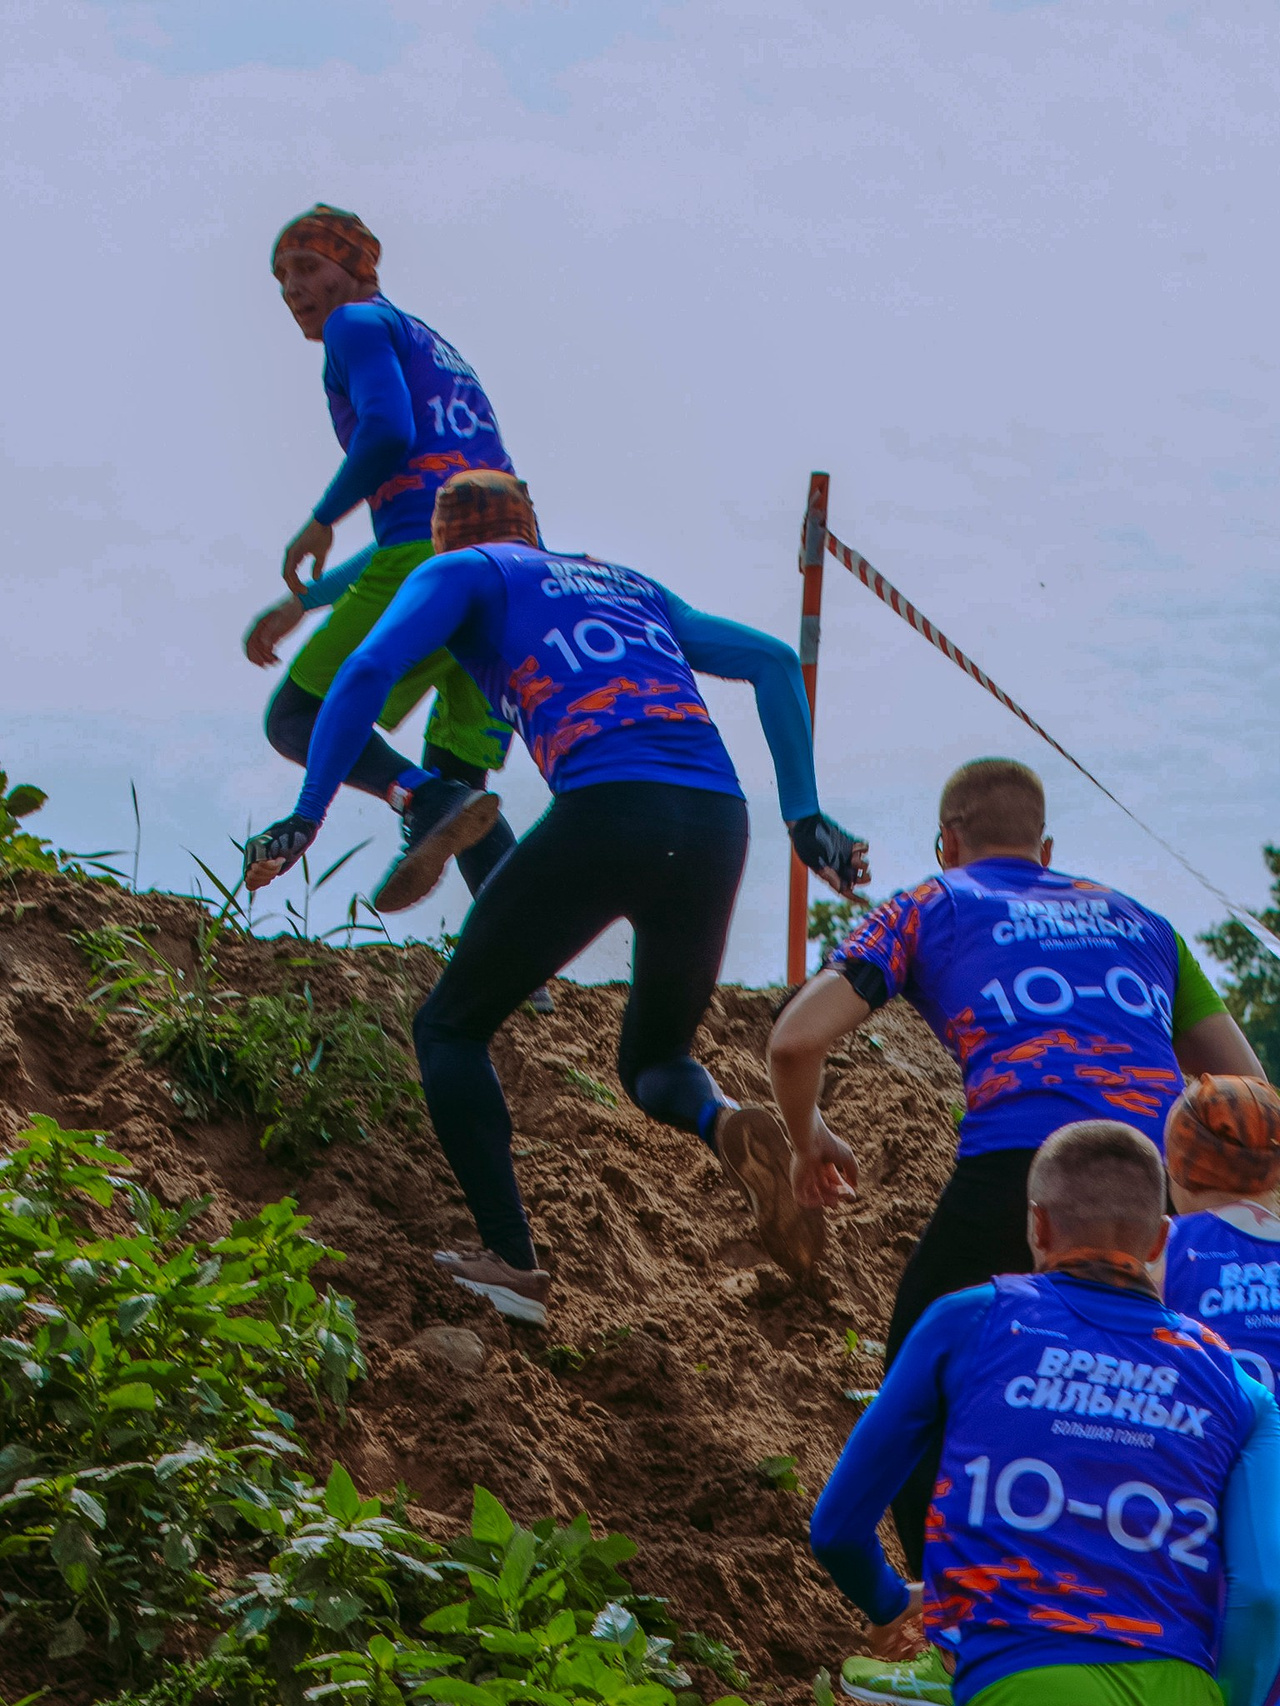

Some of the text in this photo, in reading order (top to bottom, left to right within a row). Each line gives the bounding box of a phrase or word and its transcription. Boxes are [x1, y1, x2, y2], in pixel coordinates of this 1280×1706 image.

[427, 396, 499, 439] 10-
[992, 914, 1147, 946] СИЛЬНЫХ
[1036, 1346, 1180, 1396] ВРЕМЯ
[1004, 1375, 1213, 1438] СИЛЬНЫХ
[964, 1455, 1218, 1572] 10-02
